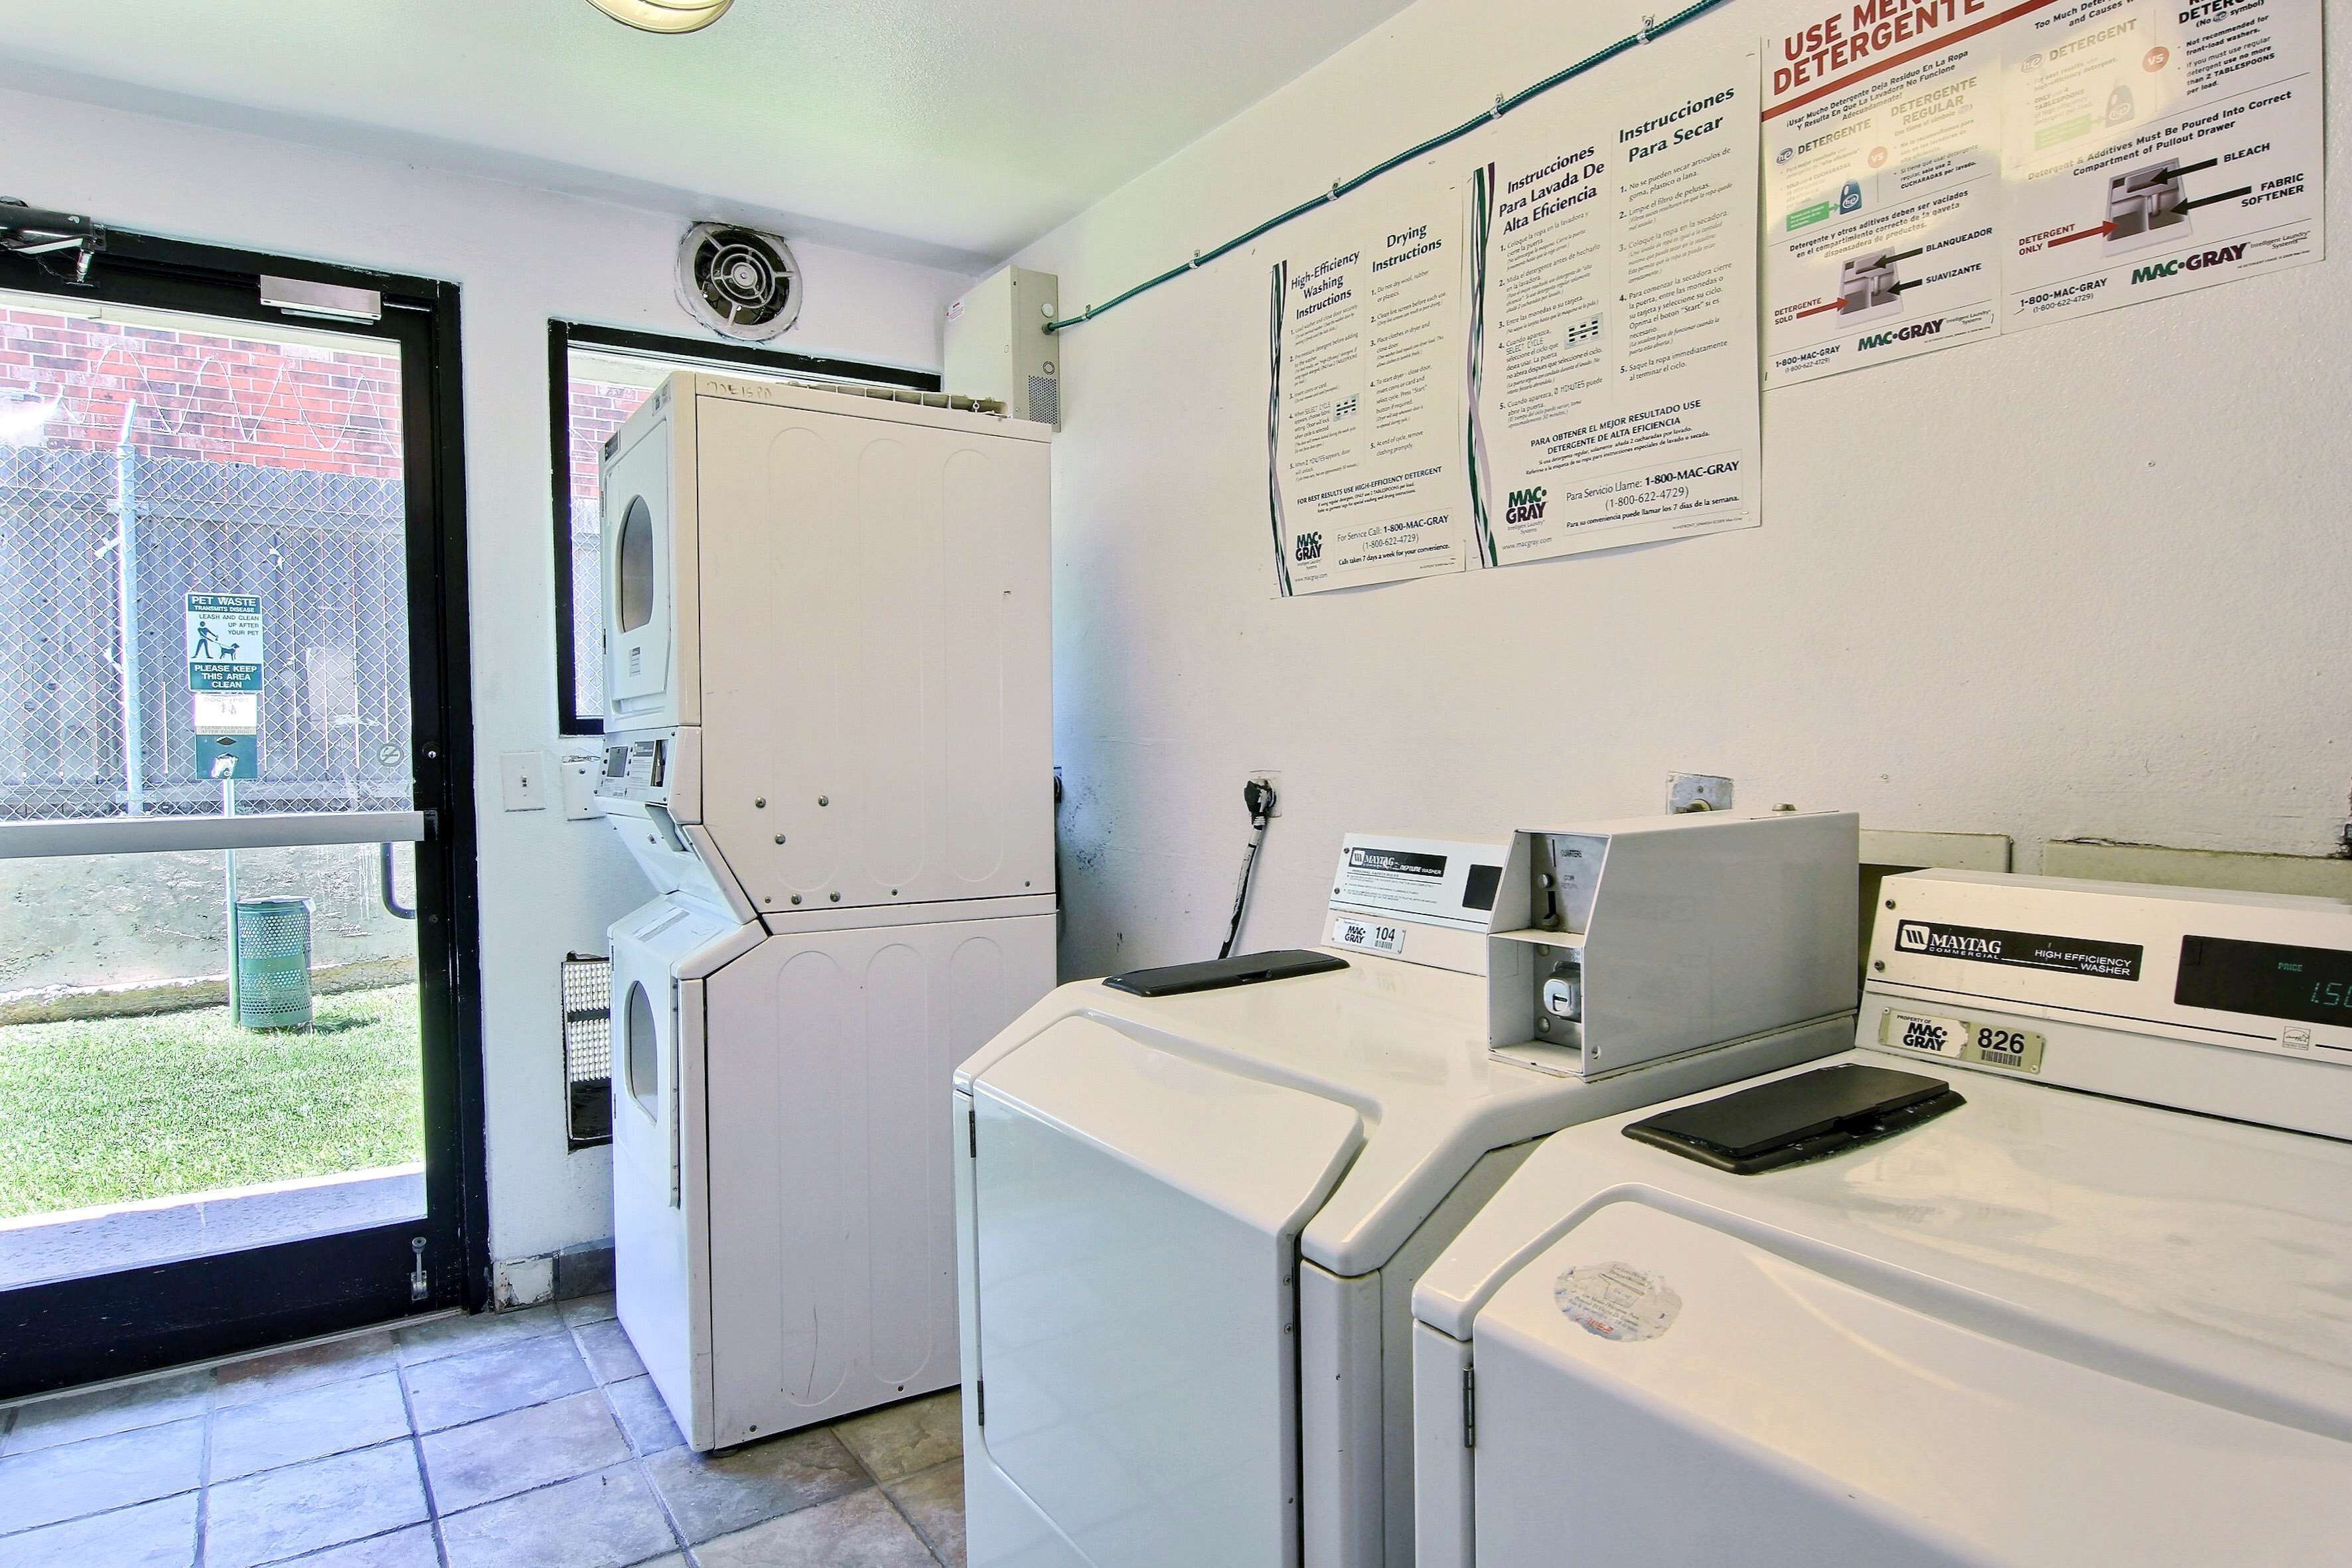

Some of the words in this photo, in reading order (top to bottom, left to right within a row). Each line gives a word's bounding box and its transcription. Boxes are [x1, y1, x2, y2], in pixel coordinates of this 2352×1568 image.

[2035, 19, 2049, 29] Too
[2053, 8, 2077, 21] Much
[2069, 14, 2085, 26] and
[2089, 1, 2122, 17] Causes
[1785, 13, 1842, 61] USE
[2049, 20, 2134, 60] DETERGENT
[2186, 38, 2199, 46] Not
[2202, 19, 2254, 40] recommended
[2186, 38, 2224, 55] front-load
[2227, 29, 2260, 41] washers.
[2147, 53, 2164, 65] VS
[2187, 61, 2221, 76] detergent
[2251, 46, 2271, 55] more
[2215, 53, 2274, 76] TABLESPOONS
[1787, 116, 1804, 127] ¡Usar
[1806, 106, 1828, 123] Mucho
[1830, 90, 1869, 112] Detergente
[1871, 82, 1887, 97] Deja
[1889, 70, 1920, 89] Residuo
[1923, 64, 1933, 76] En
[1935, 60, 1945, 70] La
[1948, 51, 1968, 62] Ropa
[1891, 77, 1976, 116] DETERGENTE
[1619, 88, 1733, 142] Instrucciones
[1903, 95, 1963, 124] REGULAR
[1798, 119, 1870, 153] DETERGENTE
[2085, 142, 2132, 161] Additives
[2136, 131, 2160, 145] Must
[2165, 127, 2177, 136] Be
[2181, 113, 2219, 130] Poured
[2223, 107, 2244, 117] Into
[2248, 91, 2291, 109] Correct
[1629, 140, 1666, 162] Para
[1674, 117, 1722, 144] Secar
[2073, 150, 2138, 175] Compartment
[2143, 145, 2152, 154] of
[2156, 133, 2193, 150] Pullout
[2197, 121, 2235, 137] Drawer
[1872, 152, 1885, 163] VS
[2224, 143, 2270, 162] BLEACH
[1508, 147, 1593, 193] Instrucciones
[2260, 173, 2303, 190] FABRIC
[1499, 198, 1526, 217] Para
[1531, 173, 1578, 201] Lavada
[1583, 163, 1603, 178] De
[2241, 184, 2303, 206] SOFTENER
[1504, 216, 1528, 234] Alta
[1533, 186, 1596, 220] Eficiencia
[1790, 236, 1828, 251] Detergente
[1837, 226, 1856, 238] otros
[1859, 216, 1889, 231] aditivos
[1891, 208, 1915, 221] deben
[1917, 202, 1929, 214] ser
[1933, 190, 1968, 206] vaciados
[1387, 225, 1426, 247] Drying
[1926, 228, 1992, 251] BLANQUEADOR
[2019, 224, 2074, 245] DETERGENT
[1372, 240, 1441, 271] Instructions
[2019, 243, 2042, 255] ONLY
[1291, 251, 1359, 290] High-Efficiency
[1926, 263, 1981, 283] SUAVIZANTE
[1304, 275, 1343, 298] Washing
[2021, 279, 2106, 306] 1-800-MAC-GRAY
[1296, 289, 1351, 319] Instructions
[1775, 297, 1821, 316] DETERGENTE
[2033, 293, 2093, 313] (1-800-622-4729)
[1775, 315, 1793, 324] SOLO
[1776, 345, 1839, 367] 1-800-MAC-GRAY
[1530, 437, 1550, 447] PARA
[1552, 427, 1586, 441] OBTENER
[1599, 417, 1625, 429] MEJOR
[1629, 405, 1680, 422] RESULTADO
[1683, 399, 1700, 409] USE
[1548, 436, 1595, 454] DETERGENTE
[1597, 433, 1607, 441] DE
[1610, 429, 1629, 439] ALTA
[1632, 417, 1680, 433] EFICIENCIA
[1321, 488, 1342, 498] RESULTS
[1355, 475, 1402, 490] HIGH-EFFICIENCY
[1404, 466, 1441, 479] DETERGENT
[1584, 484, 1613, 498] Servicio
[1646, 461, 1738, 484] 1-800-MAC-GRAY
[1605, 486, 1688, 510] (1-800-622-4729)
[1506, 502, 1546, 524] GRAY
[1347, 531, 1366, 539] Service
[1368, 527, 1381, 535] Call:
[1384, 516, 1447, 532] 1-800-MAC-GRAY
[1295, 543, 1322, 561] GRAY
[218, 598, 256, 606] WASTE
[1345, 934, 1365, 944] GRAY
[1376, 926, 1395, 942] 104
[1930, 934, 2002, 954] MAYTAG
[1929, 947, 1999, 960] COMMERCIAL
[2035, 950, 2062, 960] HIGH
[2064, 953, 2132, 967] EFFICIENCY
[2081, 963, 2130, 975] WASHER
[2278, 962, 2304, 972] PRICE
[1897, 1015, 1923, 1023] PROPERTY
[1903, 1034, 1946, 1051] GRAY
[1977, 1028, 2025, 1054] 826
